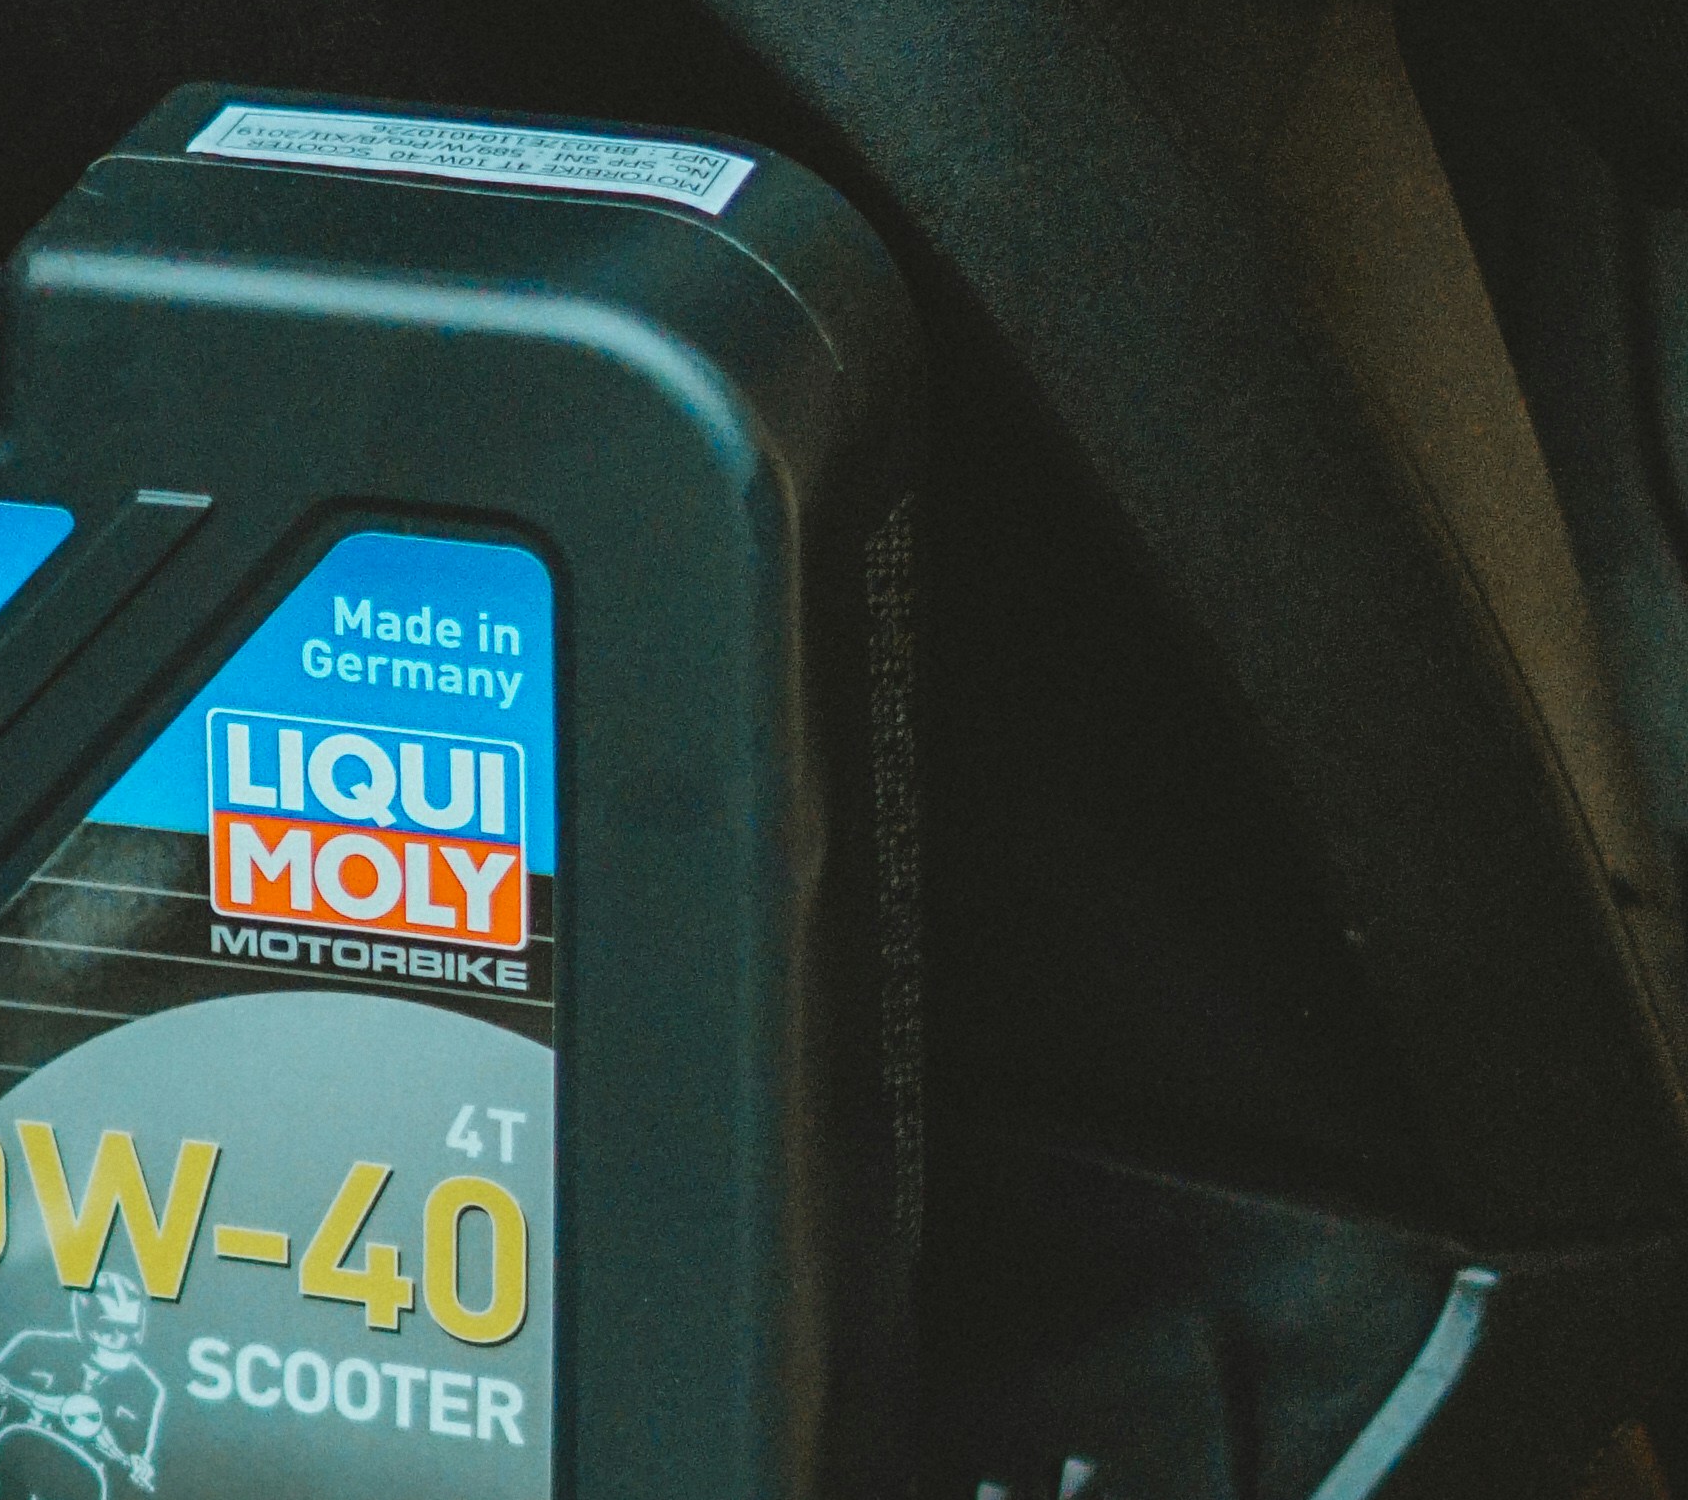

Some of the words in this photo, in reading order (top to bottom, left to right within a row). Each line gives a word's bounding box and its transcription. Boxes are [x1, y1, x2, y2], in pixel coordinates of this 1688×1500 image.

[247, 139, 372, 158] SCOOTER
[390, 151, 488, 168] 10W-40
[541, 162, 701, 192] MOTORBIKE
[553, 152, 598, 165] SNI
[333, 596, 462, 649] Made
[479, 612, 520, 656] in
[302, 638, 523, 709] Germany
[226, 722, 506, 835] LIQUI
[228, 822, 517, 933] MOLY
[211, 924, 529, 991] MOTORBIKE
[445, 1104, 527, 1164] 4T
[186, 1336, 524, 1447] SCOOTER
